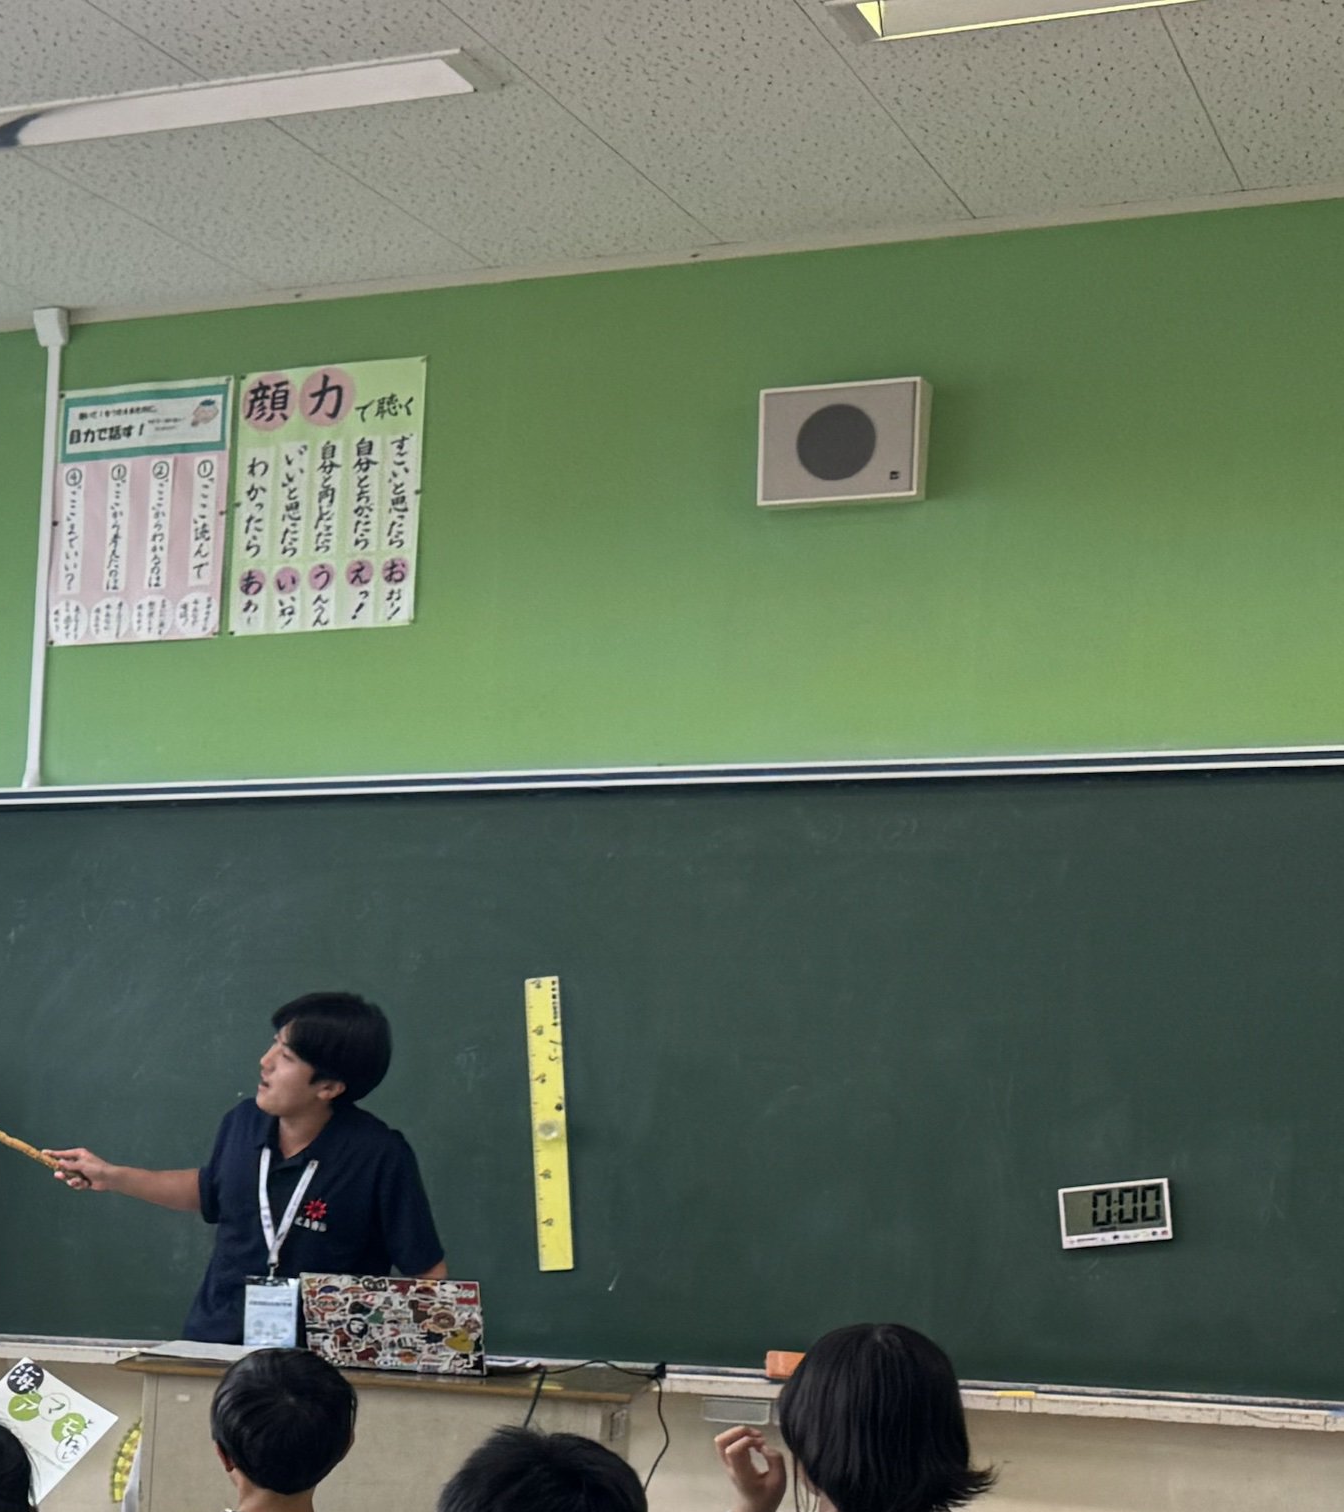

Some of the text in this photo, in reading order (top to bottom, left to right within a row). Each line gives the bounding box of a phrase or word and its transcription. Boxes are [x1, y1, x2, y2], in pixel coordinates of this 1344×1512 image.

[245, 457, 269, 558] わかったら
[1092, 1185, 1161, 1227] 0:00
